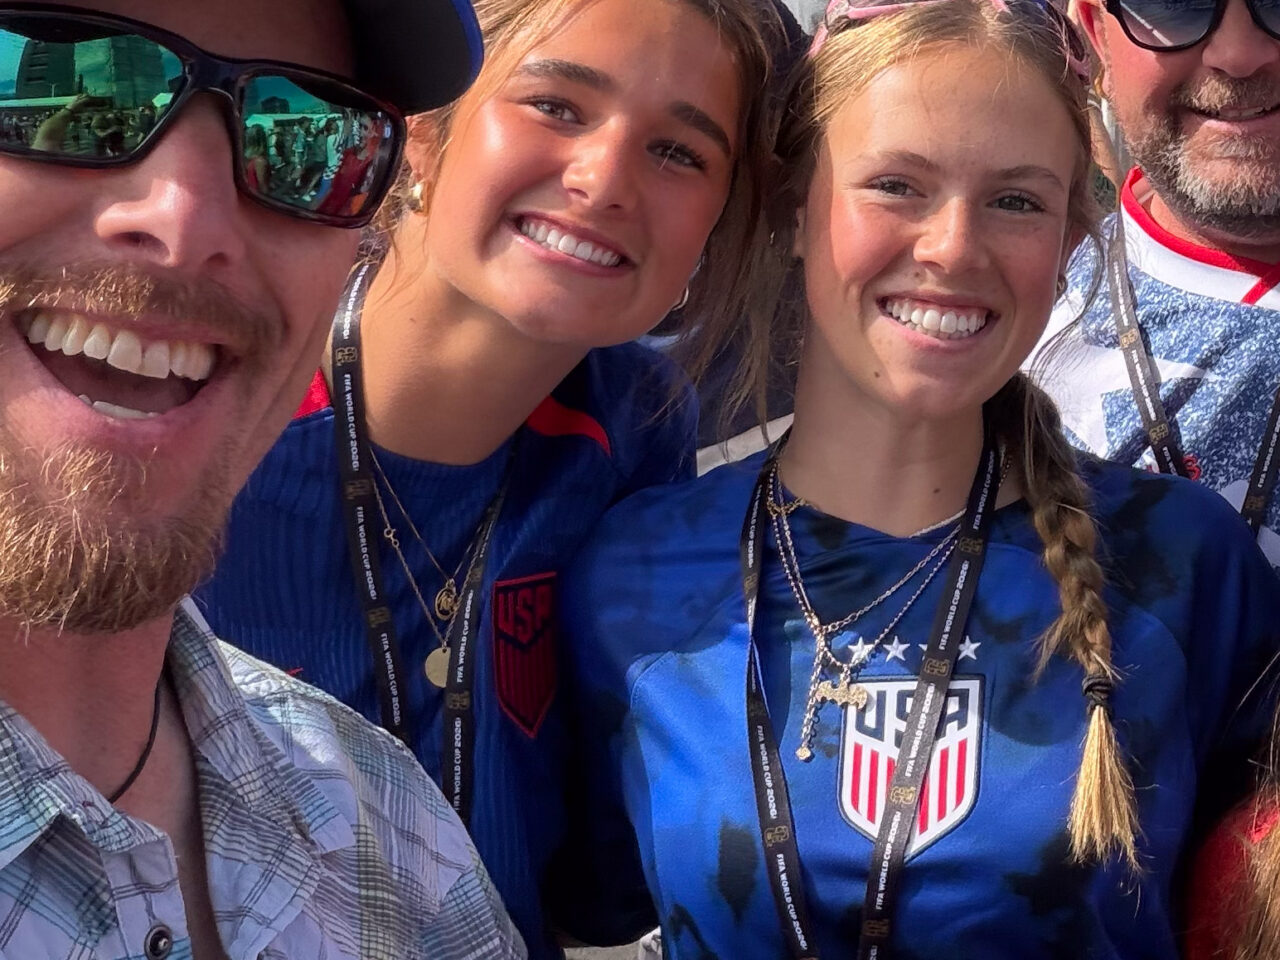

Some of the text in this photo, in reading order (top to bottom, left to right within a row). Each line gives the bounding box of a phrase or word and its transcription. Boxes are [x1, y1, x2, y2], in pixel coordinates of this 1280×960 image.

[905, 758, 915, 777] FIFA
[911, 729, 922, 758] WORLD
[917, 712, 927, 729] CUP
[759, 743, 770, 771] WORLD
[763, 771, 772, 787] CUP
[884, 844, 893, 861] CUP
[776, 854, 785, 872] FIFA
[879, 861, 889, 892] WORLD
[779, 873, 792, 903] WORLD
[875, 892, 885, 910] FIFA
[787, 903, 798, 919] CUP
